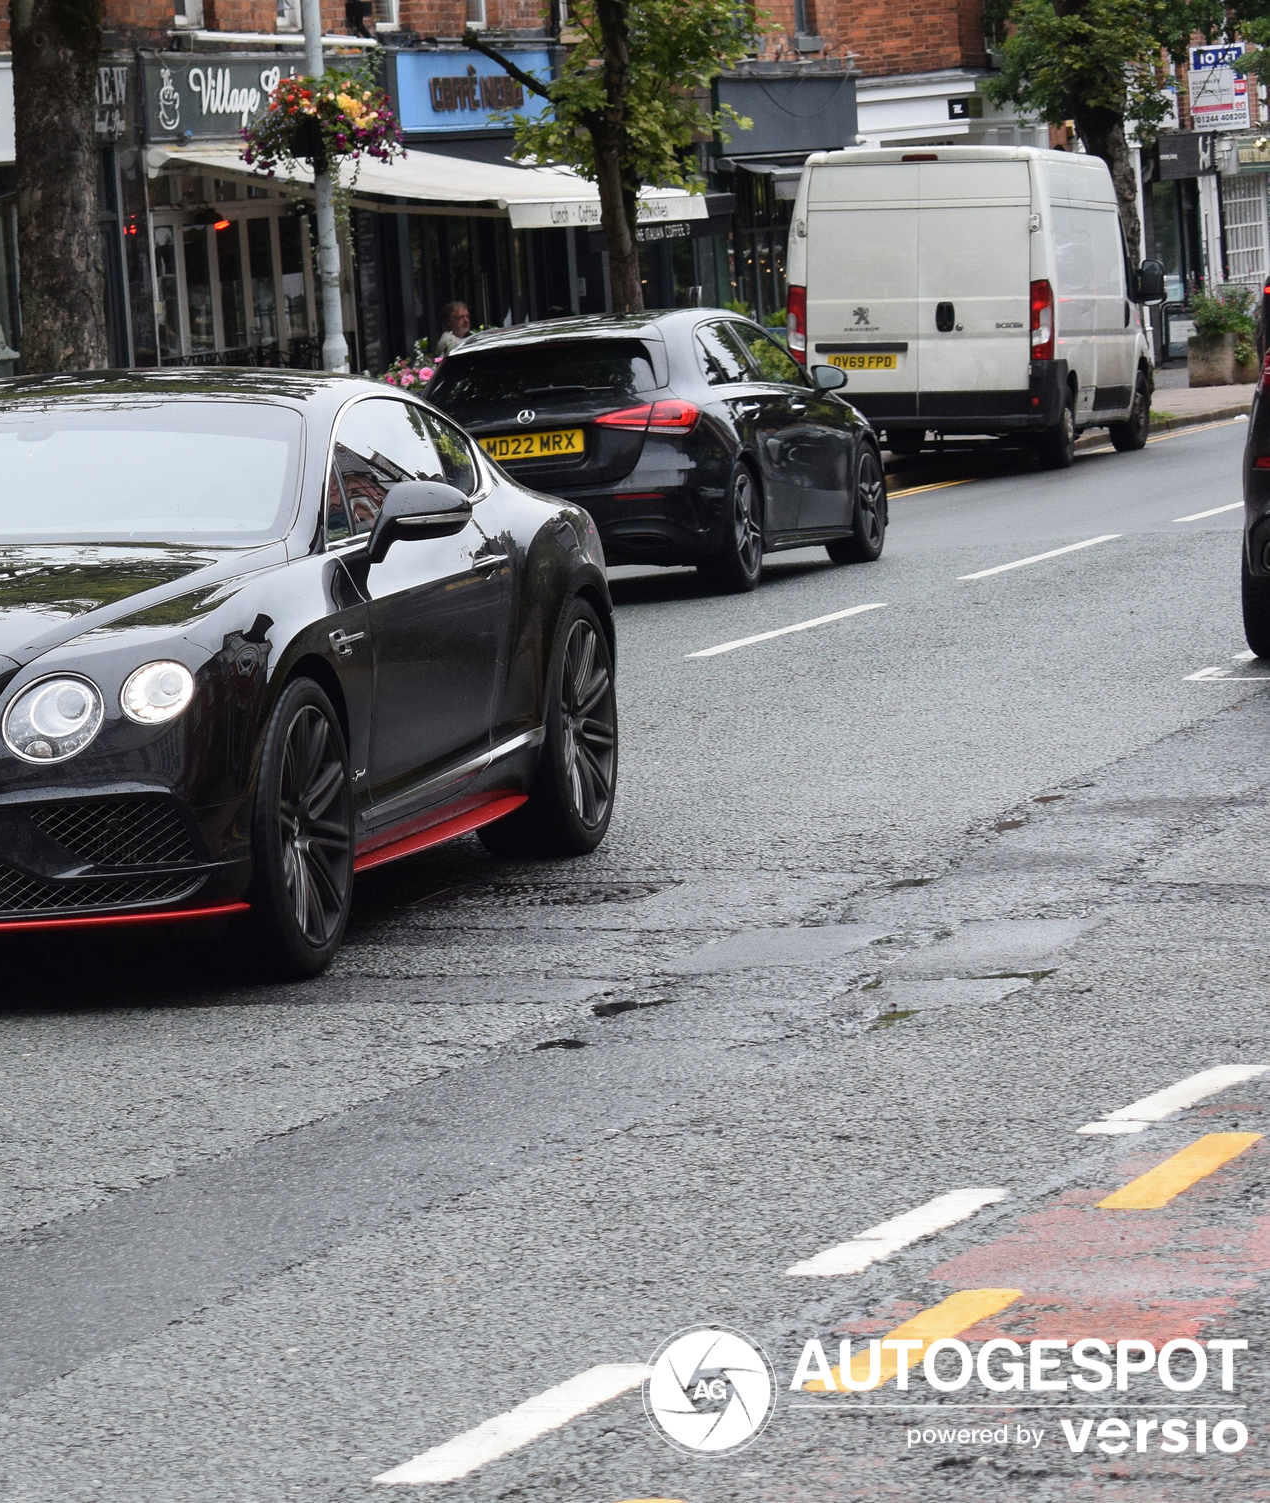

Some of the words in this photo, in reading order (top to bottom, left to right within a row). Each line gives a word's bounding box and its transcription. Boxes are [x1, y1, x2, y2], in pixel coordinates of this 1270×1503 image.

[188, 66, 260, 127] Village
[1196, 115, 1219, 124] 01244
[1221, 113, 1247, 121] 408200
[550, 203, 569, 224] Lunch
[578, 204, 598, 223] Coffee
[645, 226, 664, 241] ITALIAN
[664, 224, 685, 238] COFFEE
[833, 357, 865, 369] OV69
[868, 356, 892, 368] FPD
[486, 437, 534, 456] MD22
[540, 433, 575, 452] MRX
